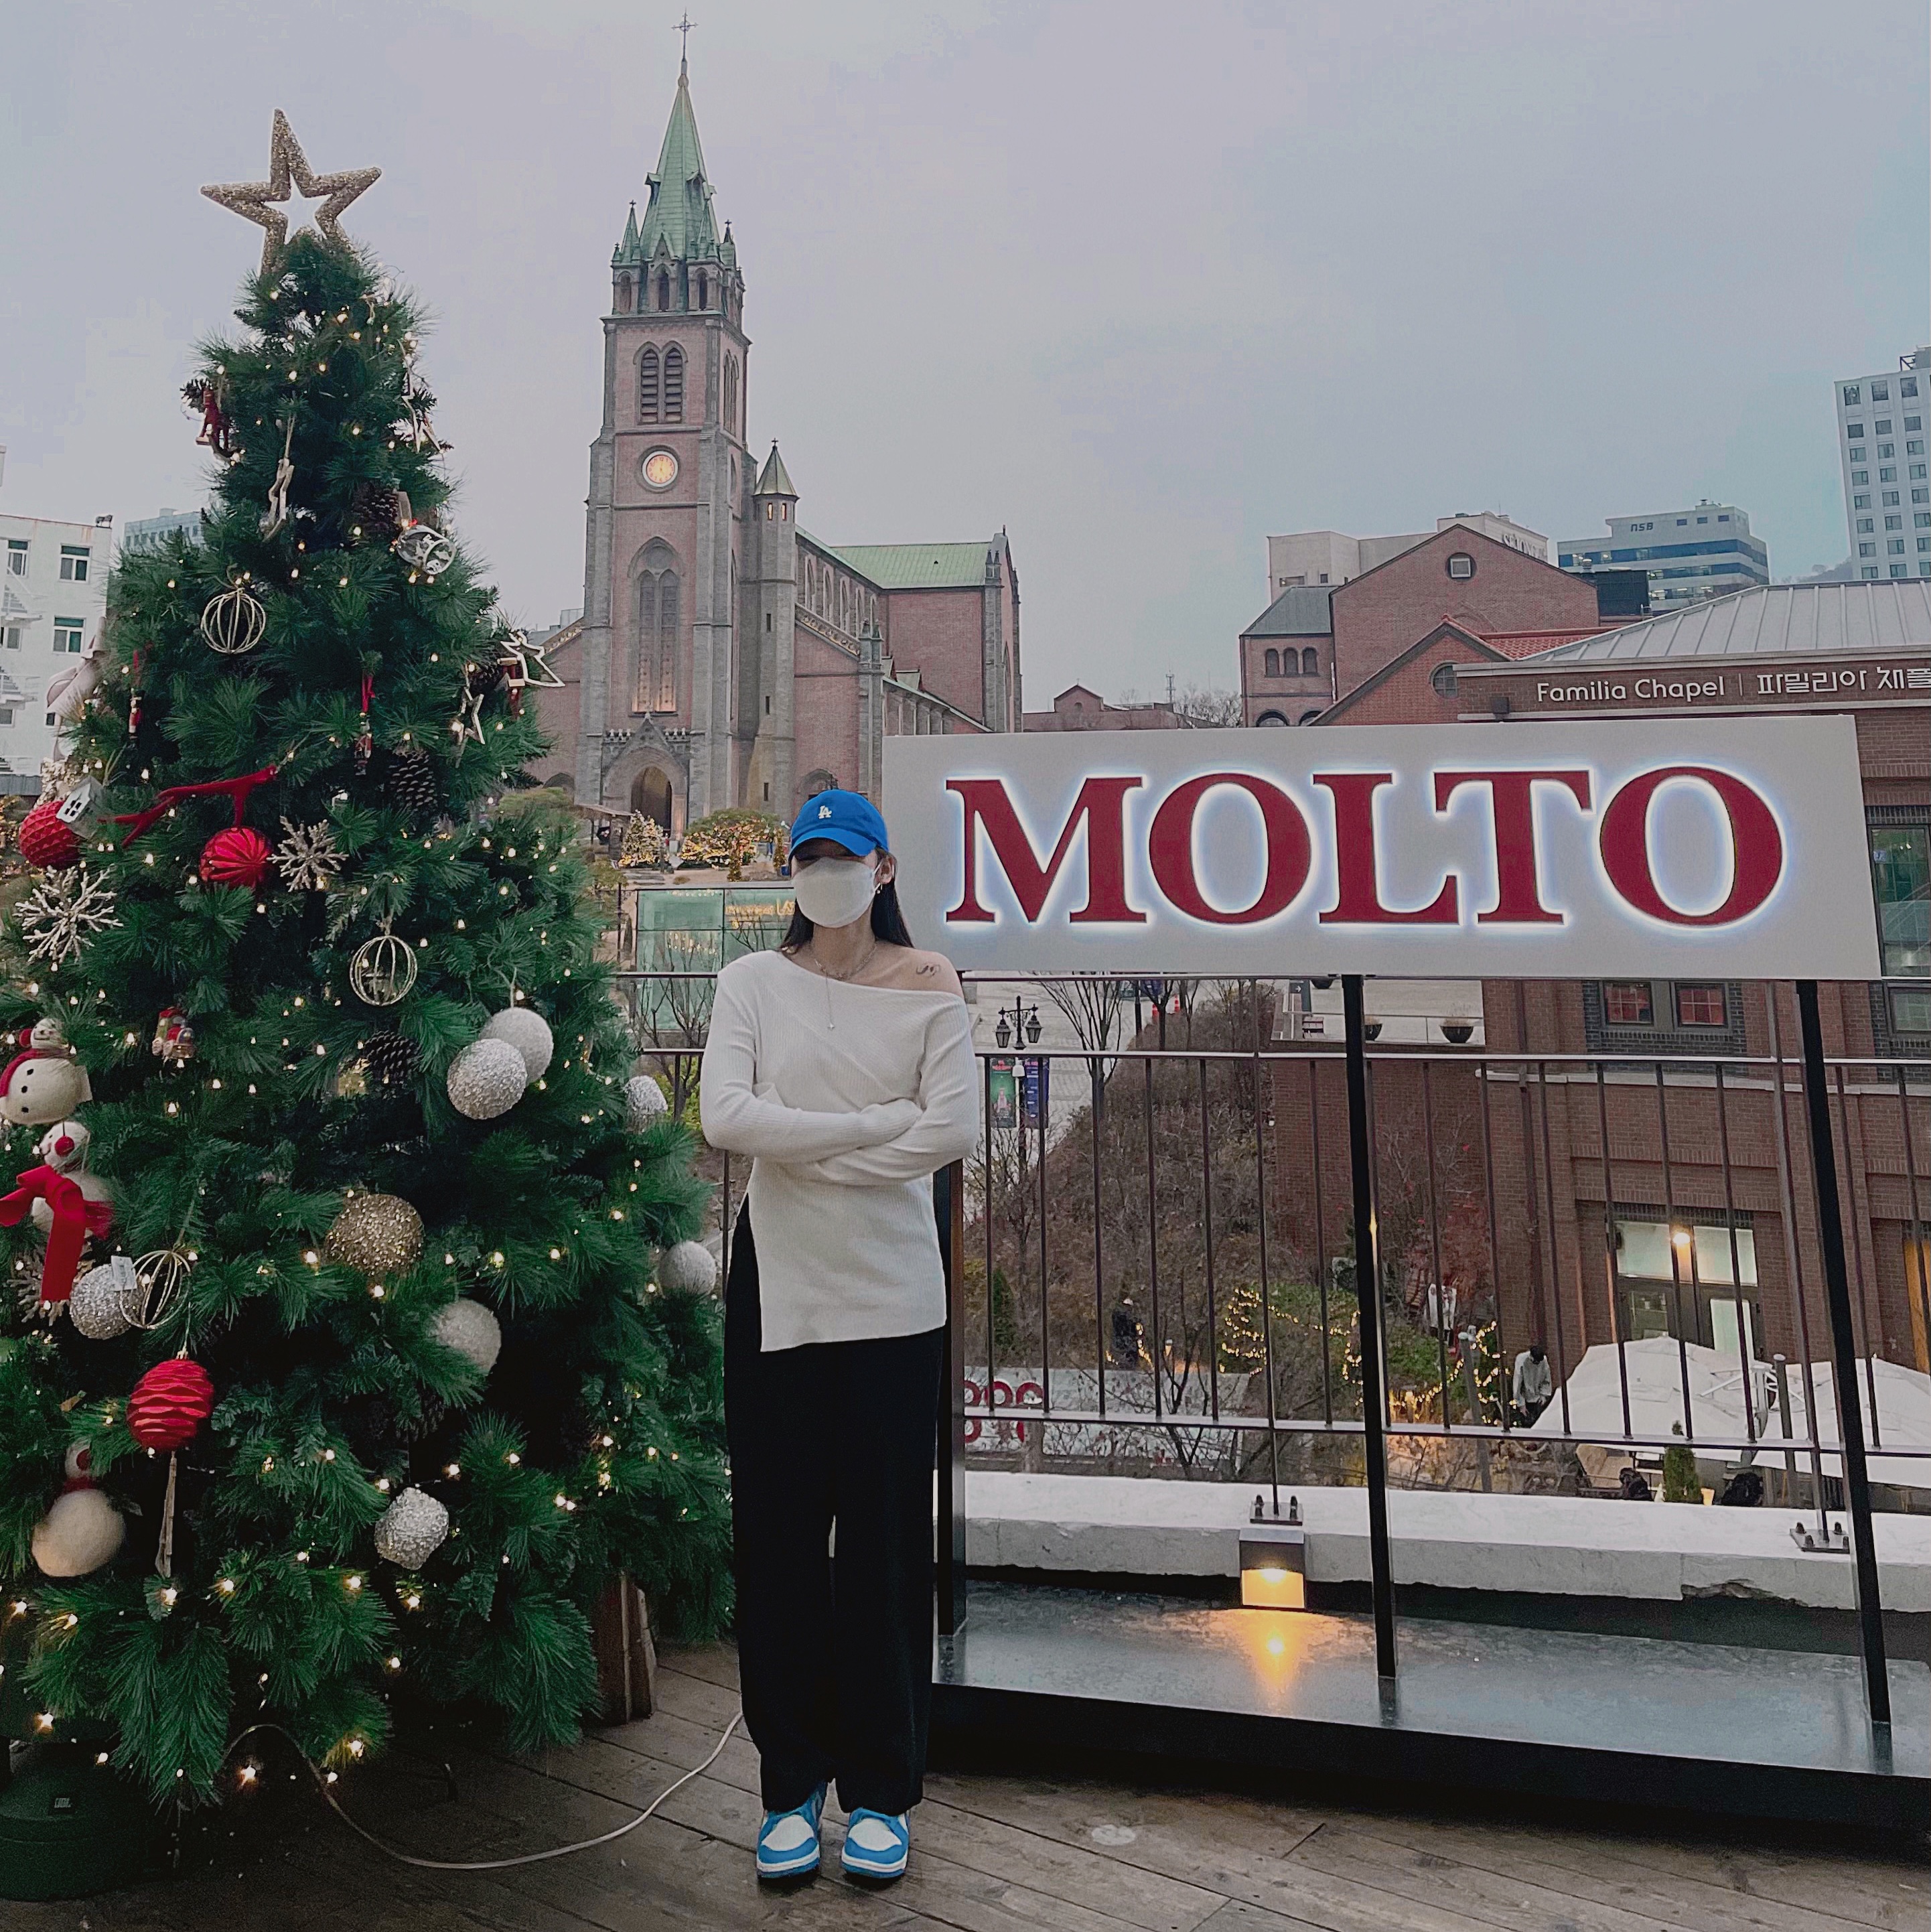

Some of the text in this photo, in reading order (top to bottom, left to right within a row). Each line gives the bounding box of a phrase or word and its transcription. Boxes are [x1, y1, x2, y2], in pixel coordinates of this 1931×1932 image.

[1536, 675, 1725, 702] Familia Chapel
[1756, 666, 1931, 694] 파밀리아 채플
[818, 805, 832, 819] LA
[945, 766, 1783, 926] MOLTO
